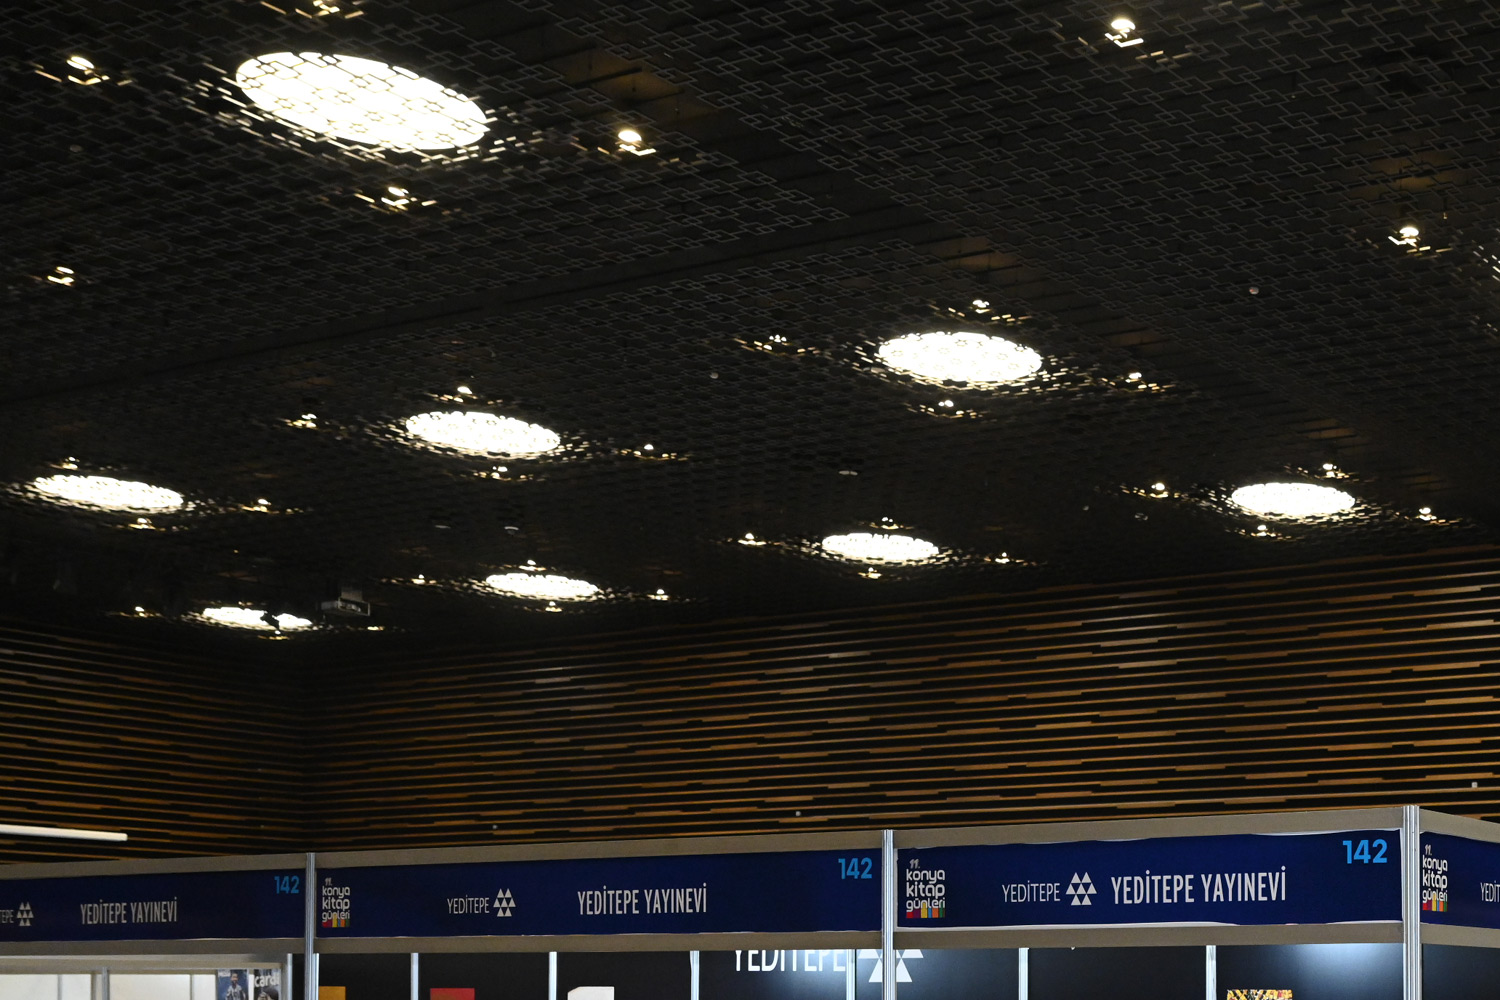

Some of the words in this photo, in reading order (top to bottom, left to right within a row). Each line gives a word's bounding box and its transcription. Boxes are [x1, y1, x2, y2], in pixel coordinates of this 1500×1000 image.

[1343, 839, 1388, 864] 142
[838, 857, 872, 880] 142
[1422, 855, 1447, 873] konya
[906, 868, 945, 883] konya
[1422, 869, 1447, 890] kitap
[274, 876, 300, 894] 142
[322, 885, 350, 899] konya
[906, 882, 945, 899] kitap
[1002, 880, 1060, 902] YEDİTEPE
[1111, 870, 1194, 904] YEDİTEPE
[1201, 866, 1286, 902] YAYINEVİ
[322, 897, 350, 912] kitap
[447, 895, 490, 914] YEDİTEPE
[577, 885, 639, 915] YEDİTEPE
[644, 882, 707, 914] YAYINEVİ
[906, 897, 945, 912] günleri
[1422, 889, 1447, 903] günleri
[80, 898, 127, 925] YEDİTEPE
[131, 896, 177, 923] YAYINEVİ
[322, 910, 350, 923] günleri
